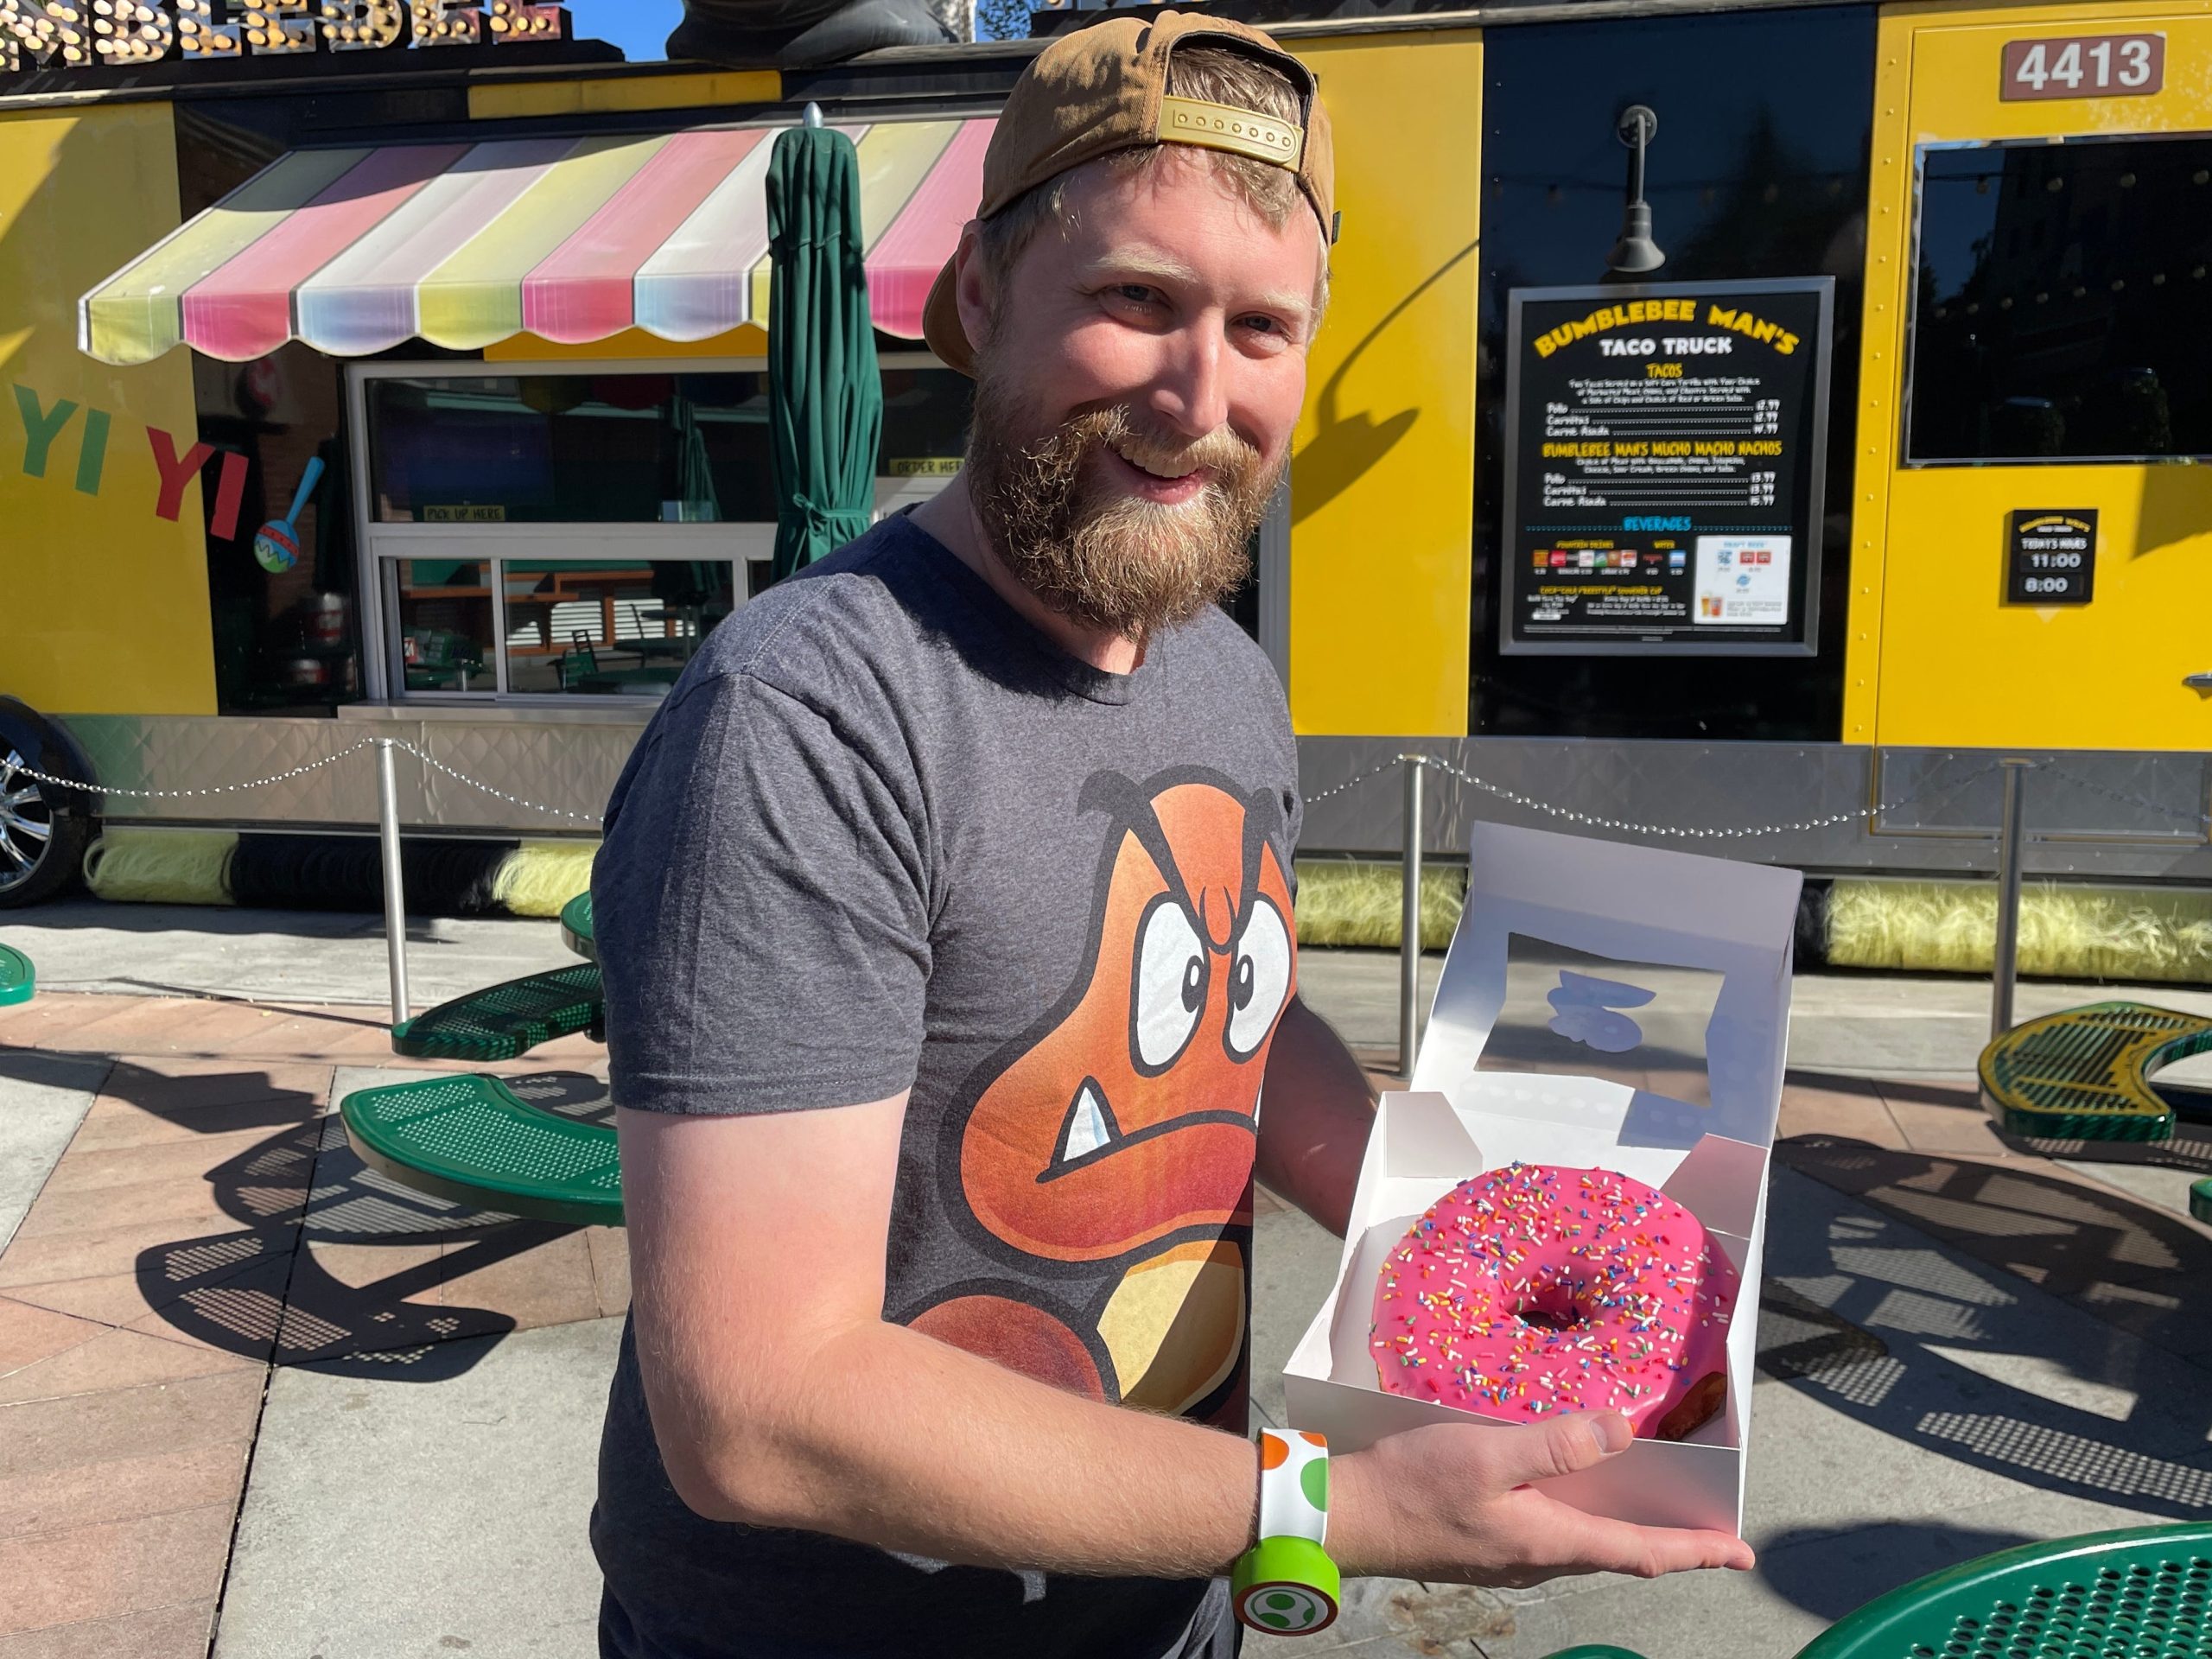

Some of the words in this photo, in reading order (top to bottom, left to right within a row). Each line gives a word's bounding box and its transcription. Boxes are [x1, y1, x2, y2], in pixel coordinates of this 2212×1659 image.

[2016, 40, 2151, 90] 4413
[1534, 298, 1697, 359] BUMBLEBEE
[1708, 304, 1800, 355] MAN'S
[1599, 338, 1656, 356] TACO
[1662, 336, 1732, 355] TRUCK
[1646, 363, 1683, 378] TACOS
[1547, 402, 1568, 414] Pollo
[1546, 414, 1590, 424] Carnitas
[1546, 425, 1579, 436] Carne
[1580, 424, 1610, 435] Asada
[1542, 442, 1611, 457] BUMBLEBEE
[1614, 442, 1649, 457] MAN'S
[1652, 441, 1691, 456] MUCHO
[1694, 441, 1735, 456] MACHO
[1738, 440, 1783, 455] NACHOS
[1544, 473, 1566, 484] Pollo
[1543, 484, 1586, 495] Carnitas
[1543, 496, 1576, 506] Carne
[1578, 495, 1607, 506] Asada
[1623, 517, 1691, 531] BEVERAGES
[2021, 537, 2057, 550] TODAY'S
[2031, 553, 2081, 568] 11:00
[2024, 577, 2068, 592] 8:00
